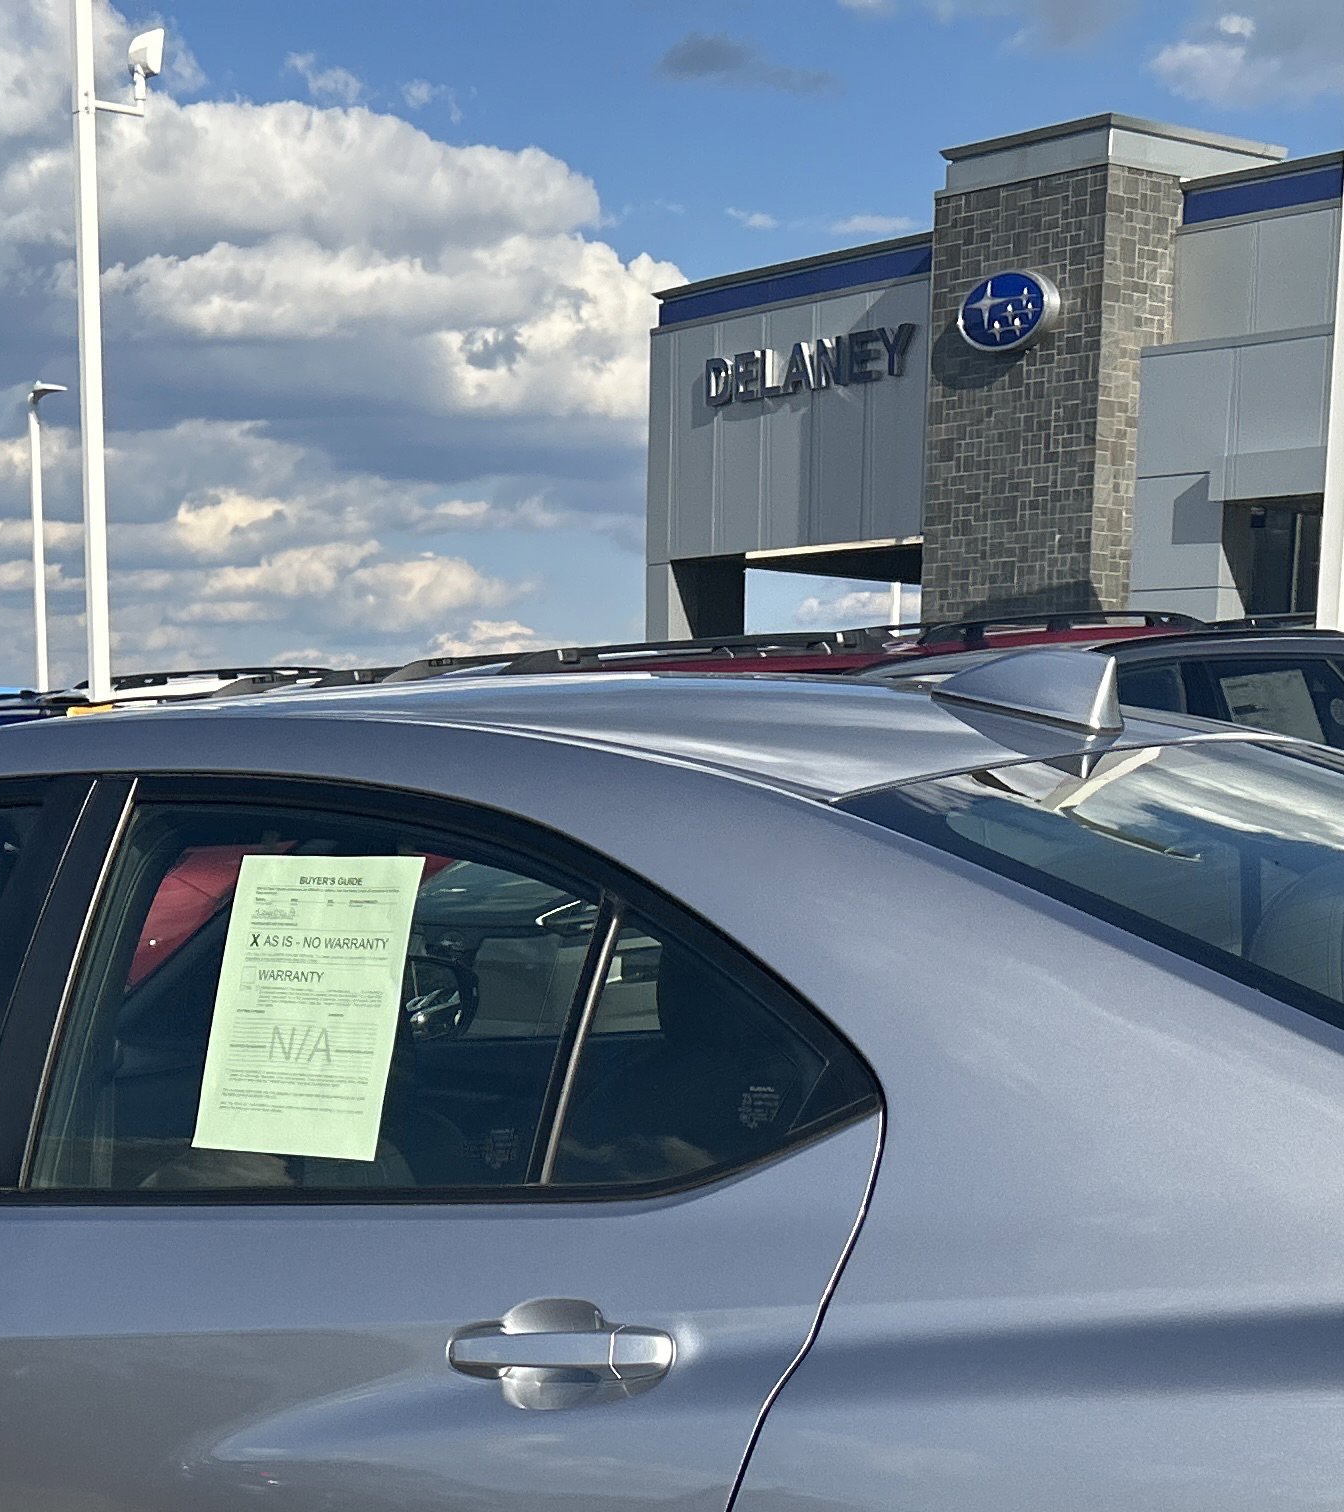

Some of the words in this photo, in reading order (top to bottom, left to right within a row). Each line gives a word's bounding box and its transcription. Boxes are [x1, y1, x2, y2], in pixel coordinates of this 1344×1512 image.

[706, 323, 918, 407] DELANEY
[299, 876, 335, 885] BUYER'S
[338, 877, 363, 886] GUIDE
[250, 933, 260, 947] X
[264, 935, 279, 947] AS
[282, 935, 293, 947] IS
[303, 936, 321, 949] NO
[325, 937, 389, 950] WARRANTY
[258, 969, 324, 983] WARRANTY
[269, 1025, 331, 1063] N/A
